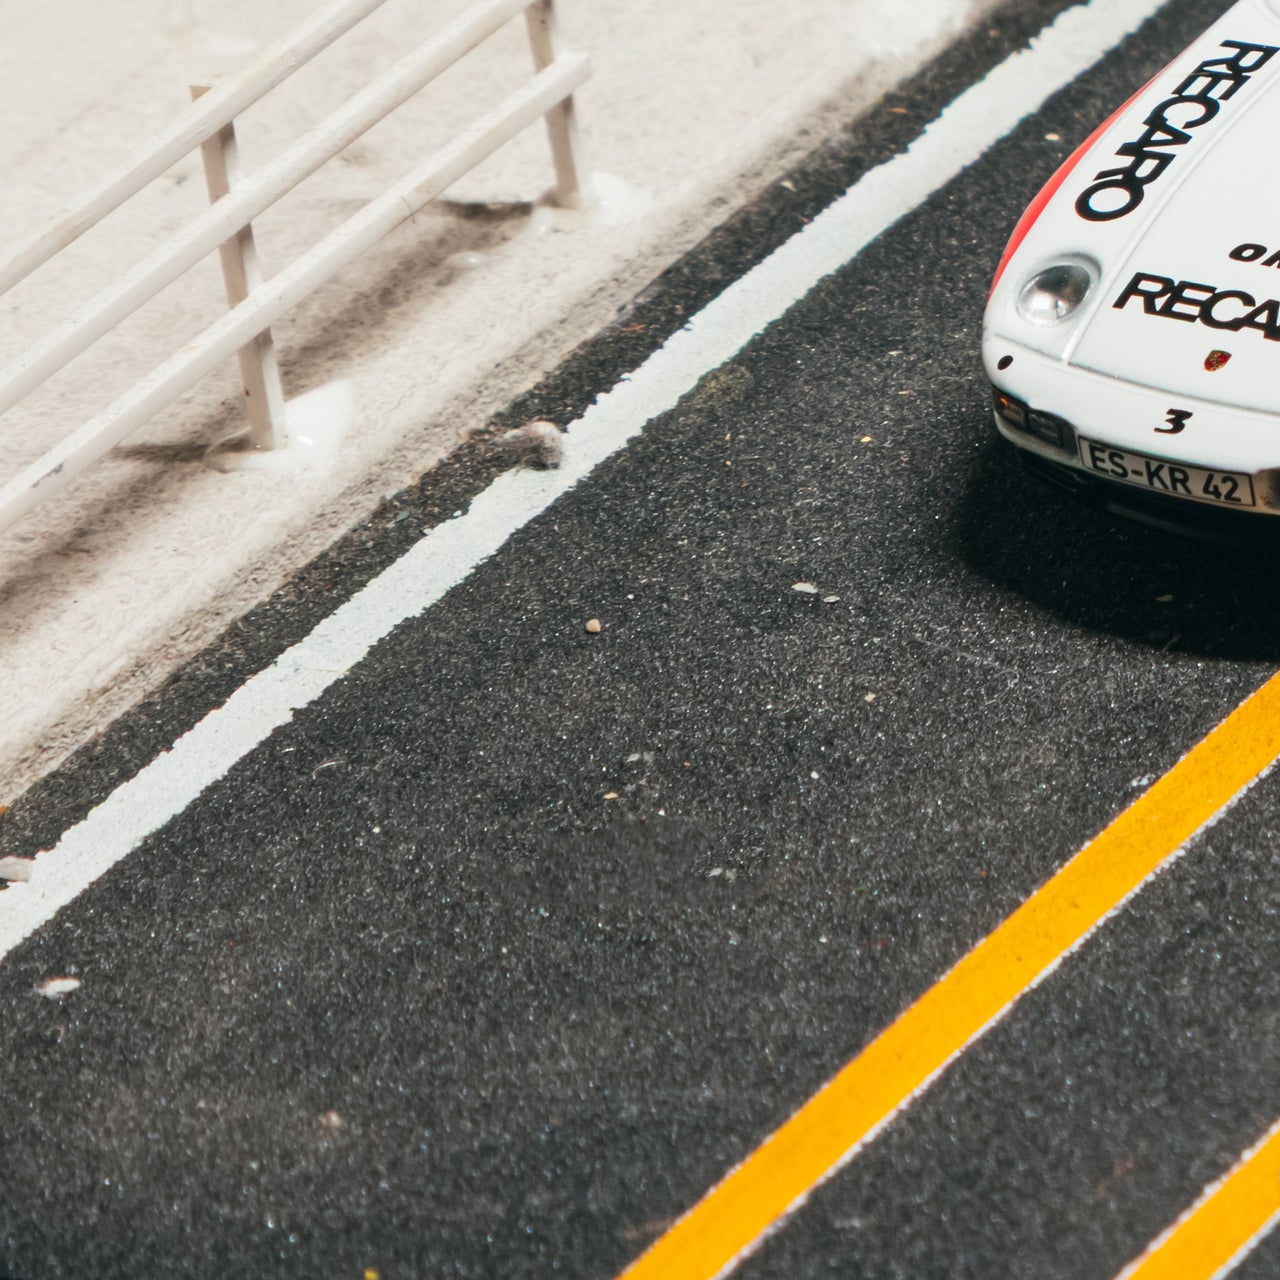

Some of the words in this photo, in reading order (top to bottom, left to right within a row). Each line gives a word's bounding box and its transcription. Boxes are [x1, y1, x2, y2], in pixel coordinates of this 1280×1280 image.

[1154, 408, 1193, 434] 3
[1089, 442, 1193, 496] ES-KR
[1202, 473, 1242, 503] 42
